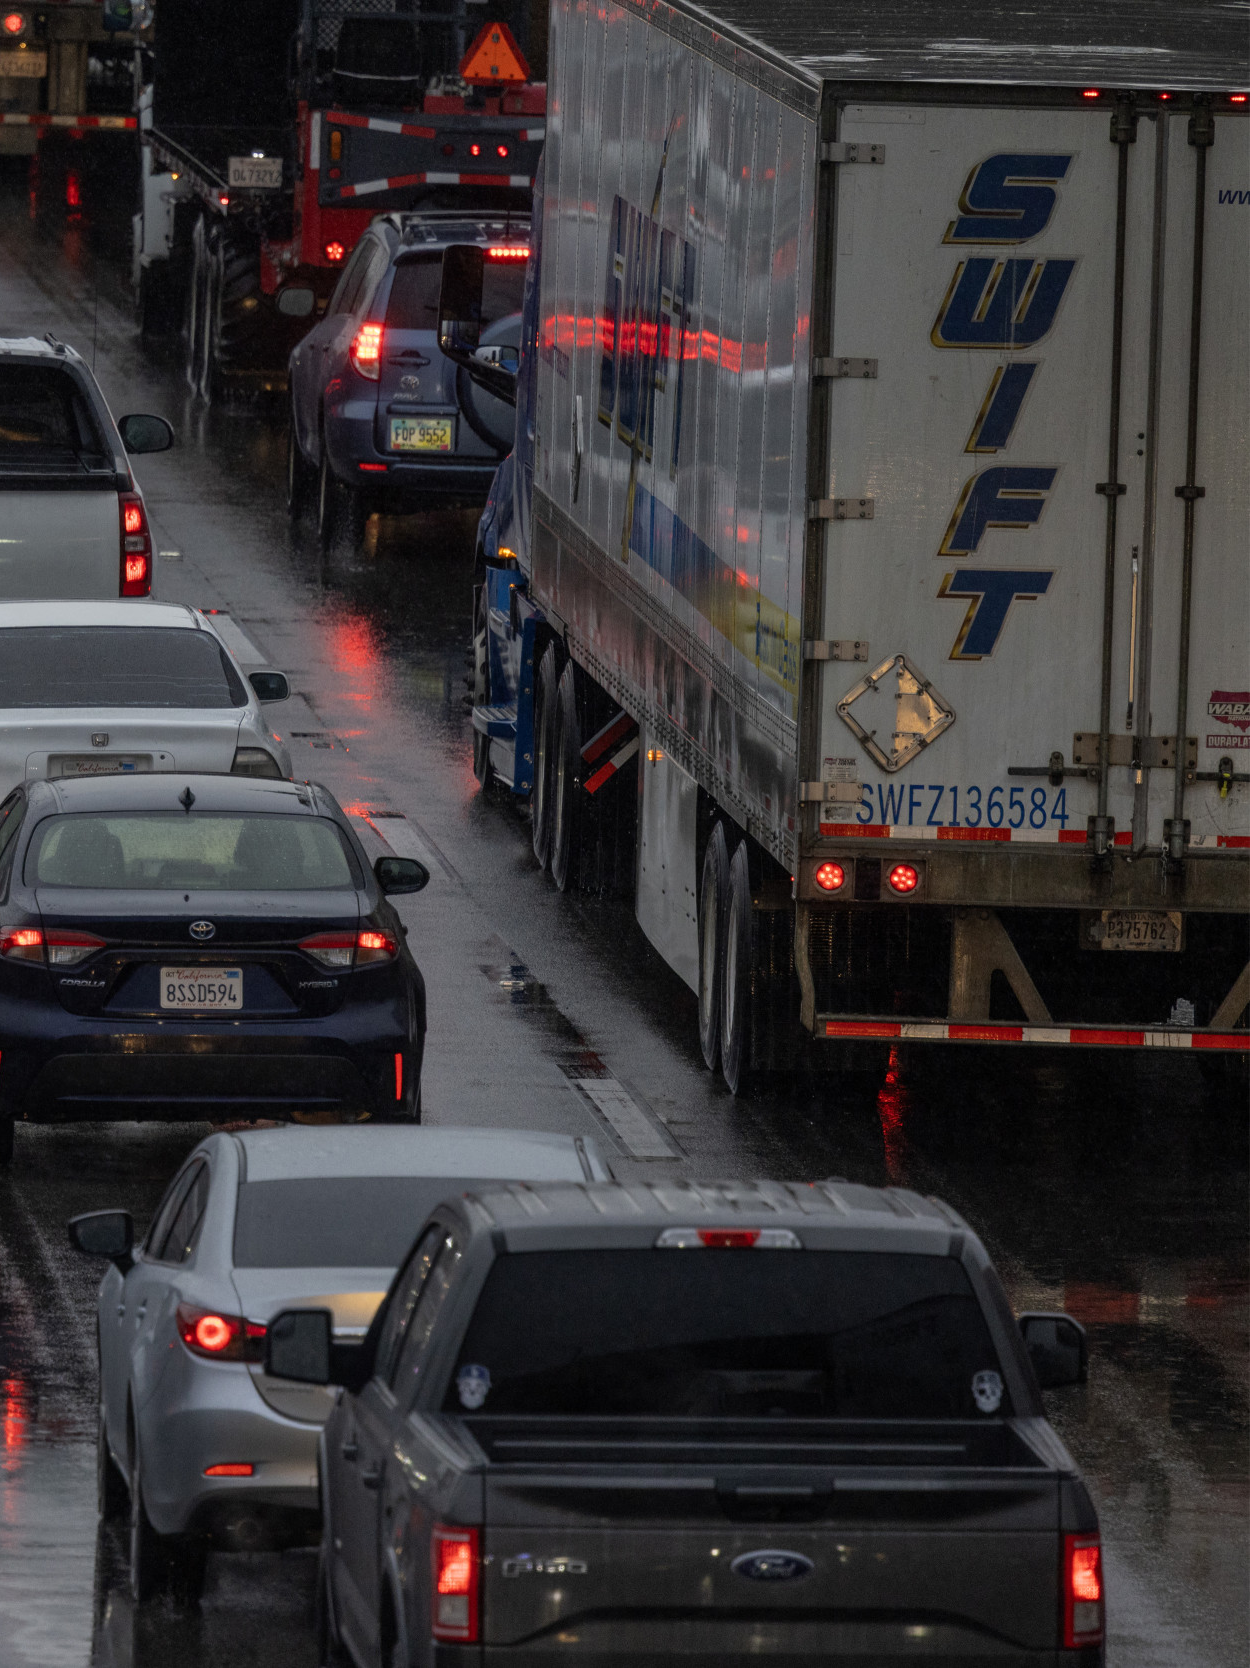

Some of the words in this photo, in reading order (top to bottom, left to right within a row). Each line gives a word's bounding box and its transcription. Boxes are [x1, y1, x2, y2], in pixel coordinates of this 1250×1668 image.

[930, 150, 1083, 662] SWIFT
[855, 782, 1070, 829] SWFZ136584
[1107, 921, 1167, 940] P375762
[59, 978, 107, 988] COROLLA
[177, 969, 223, 983] California
[166, 983, 238, 1003] 8SSD594
